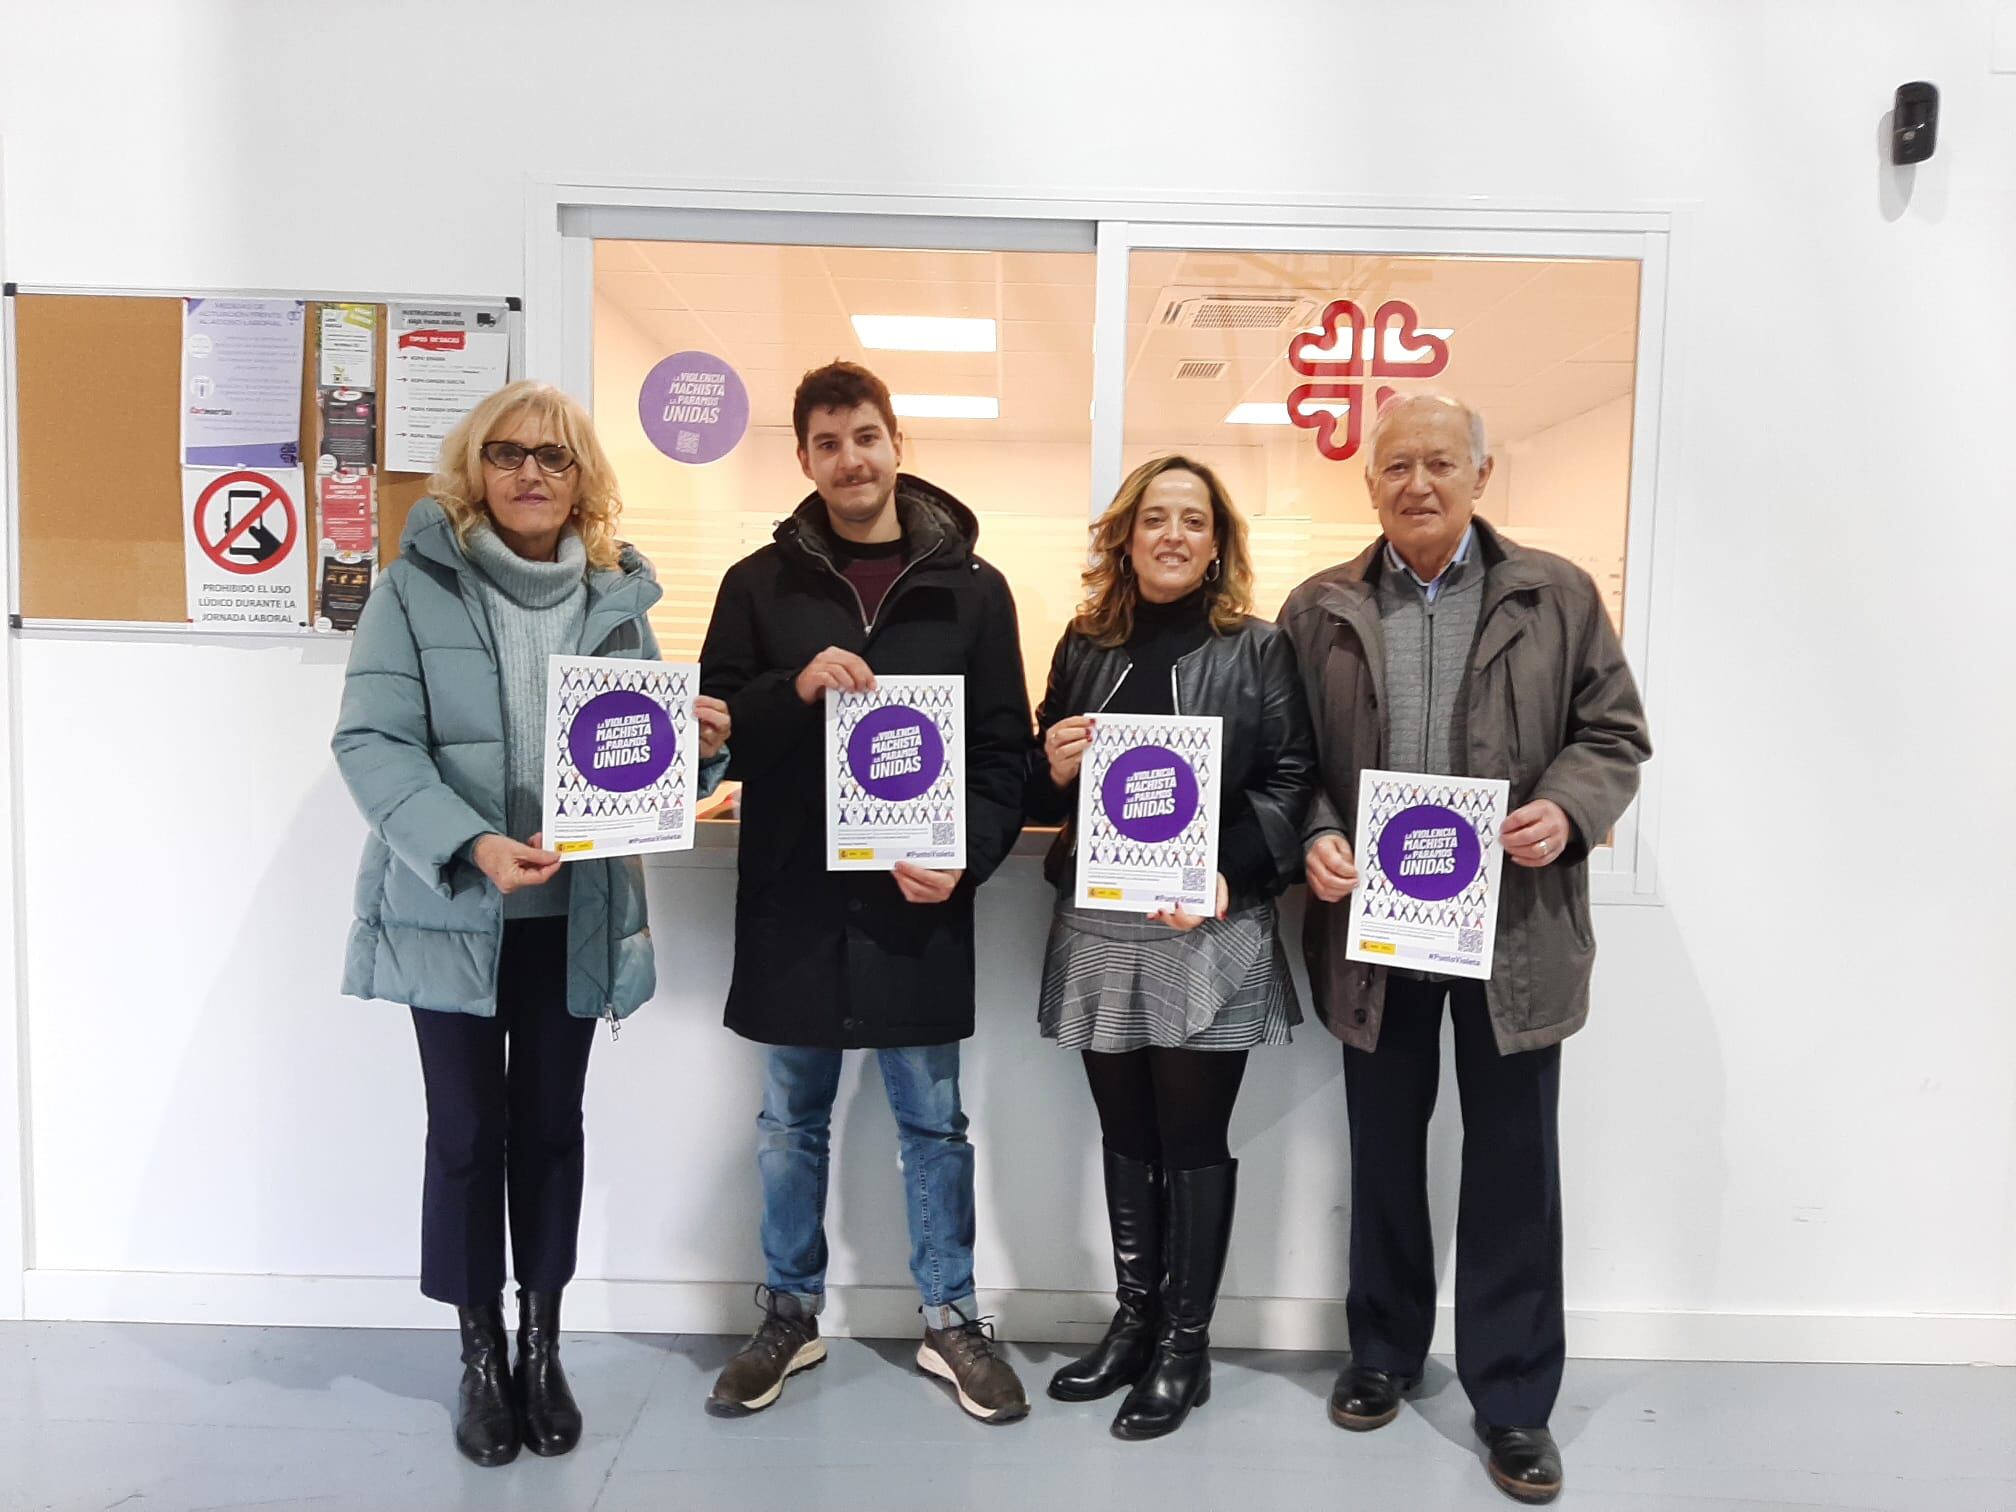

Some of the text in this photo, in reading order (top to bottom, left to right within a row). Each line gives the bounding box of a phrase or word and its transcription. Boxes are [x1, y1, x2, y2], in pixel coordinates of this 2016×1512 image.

[680, 372, 726, 383] VIOLENCIA
[668, 382, 725, 396] MACHISTA
[678, 395, 720, 406] PARAMOS
[663, 405, 720, 423] UNIDAS
[203, 584, 291, 594] PROHIBIDO EL USO
[199, 597, 296, 609] LÚDICO DURANTE LA
[202, 613, 293, 623] JORNADA LABORAL
[604, 713, 650, 728] VIOLENCIA
[595, 722, 652, 741] MACHISTA
[878, 725, 920, 740] VIOLENCIA
[606, 736, 648, 750] PARAMOS
[871, 734, 922, 754] MACHISTA
[593, 745, 651, 769] UNIDAS
[881, 746, 919, 761] PARAMOS
[870, 756, 922, 780] UNIDAS
[1133, 766, 1176, 781] VIOLENCIA
[1125, 776, 1177, 794] MACHISTA
[1134, 788, 1173, 802] PARAMOS
[1122, 798, 1176, 820] UNIDAS
[1412, 827, 1457, 839] VIOLENCIA
[1403, 836, 1458, 851] MACHISTA
[1412, 848, 1453, 860] PARAMOS
[1399, 857, 1456, 876] UNIDAS
